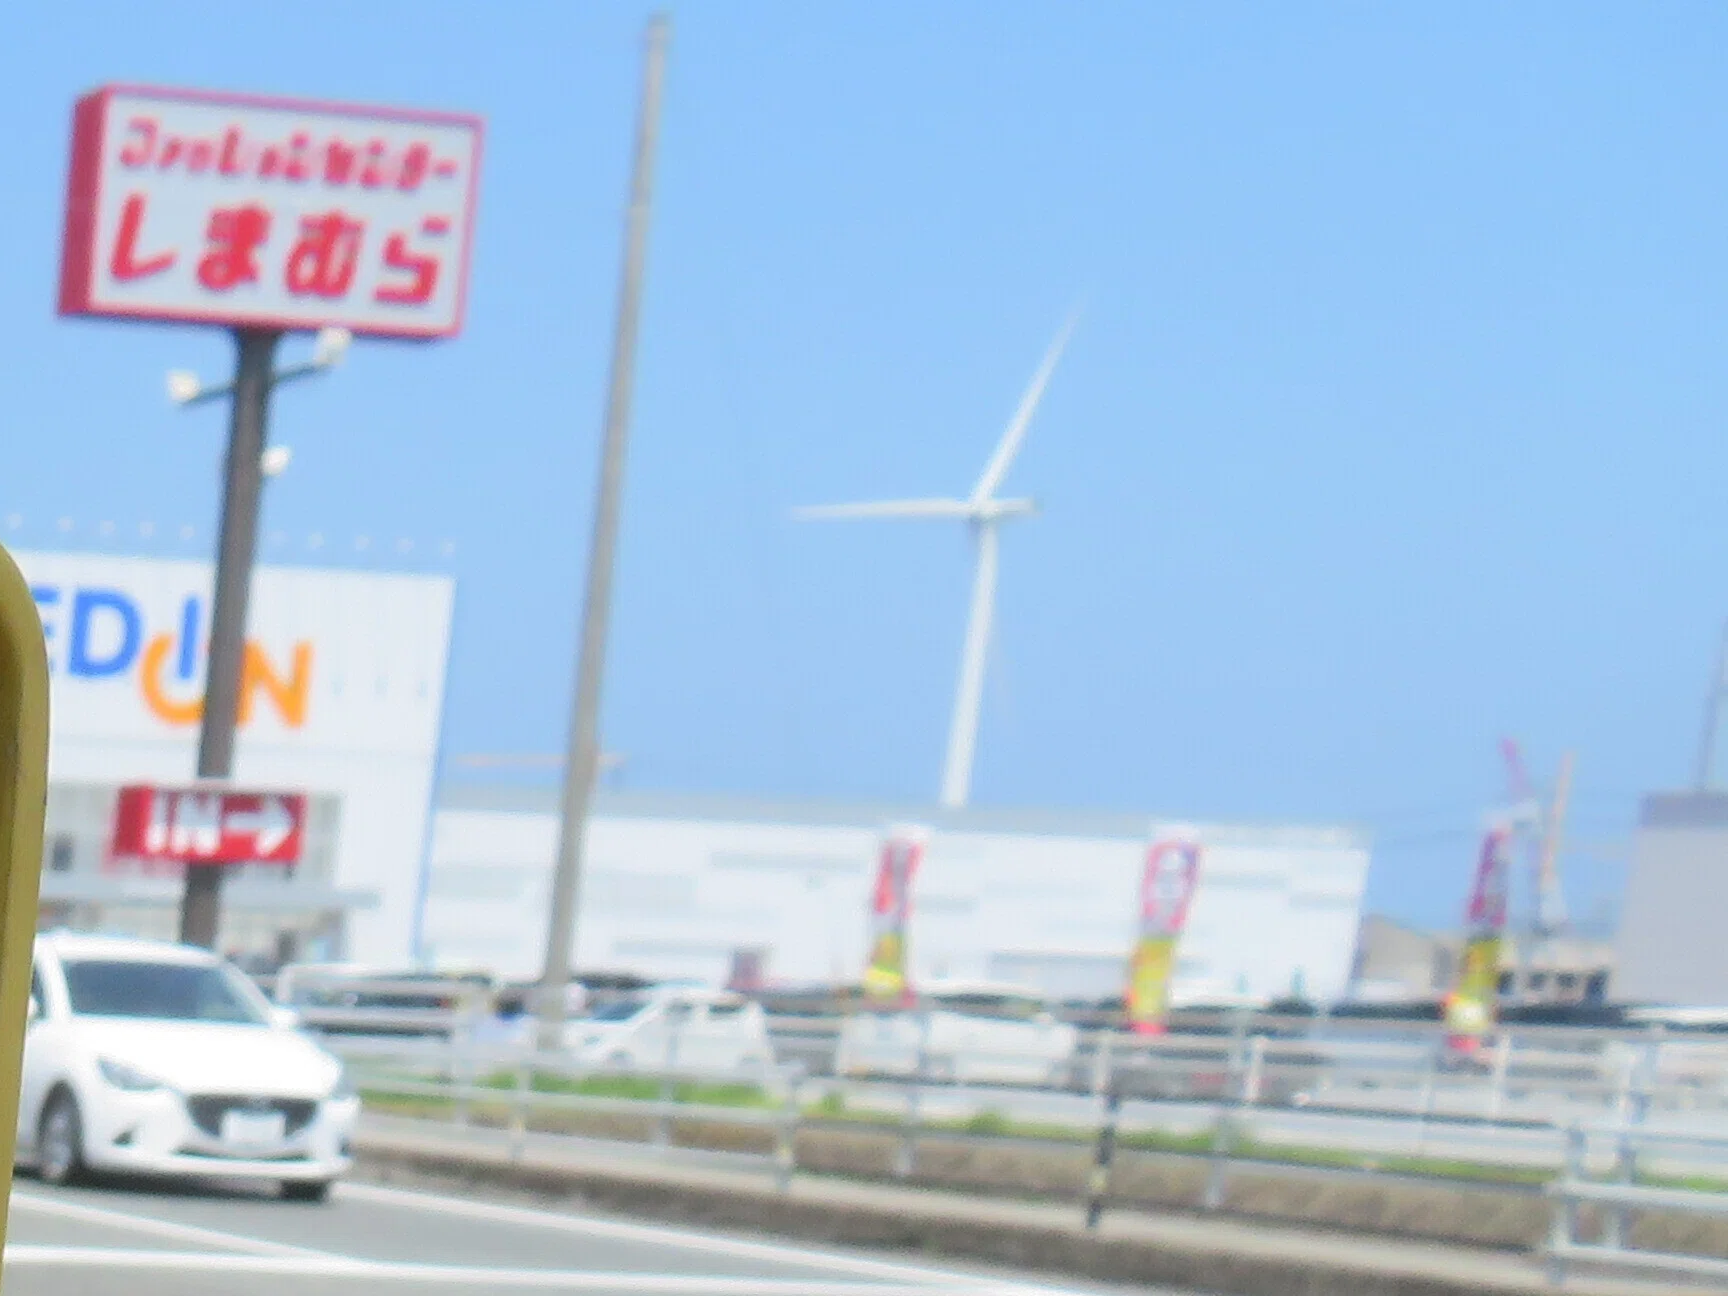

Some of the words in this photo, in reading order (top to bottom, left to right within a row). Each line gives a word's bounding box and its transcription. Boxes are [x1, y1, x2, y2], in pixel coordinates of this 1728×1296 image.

[110, 193, 451, 304] しまむら
[145, 795, 222, 857] IN
